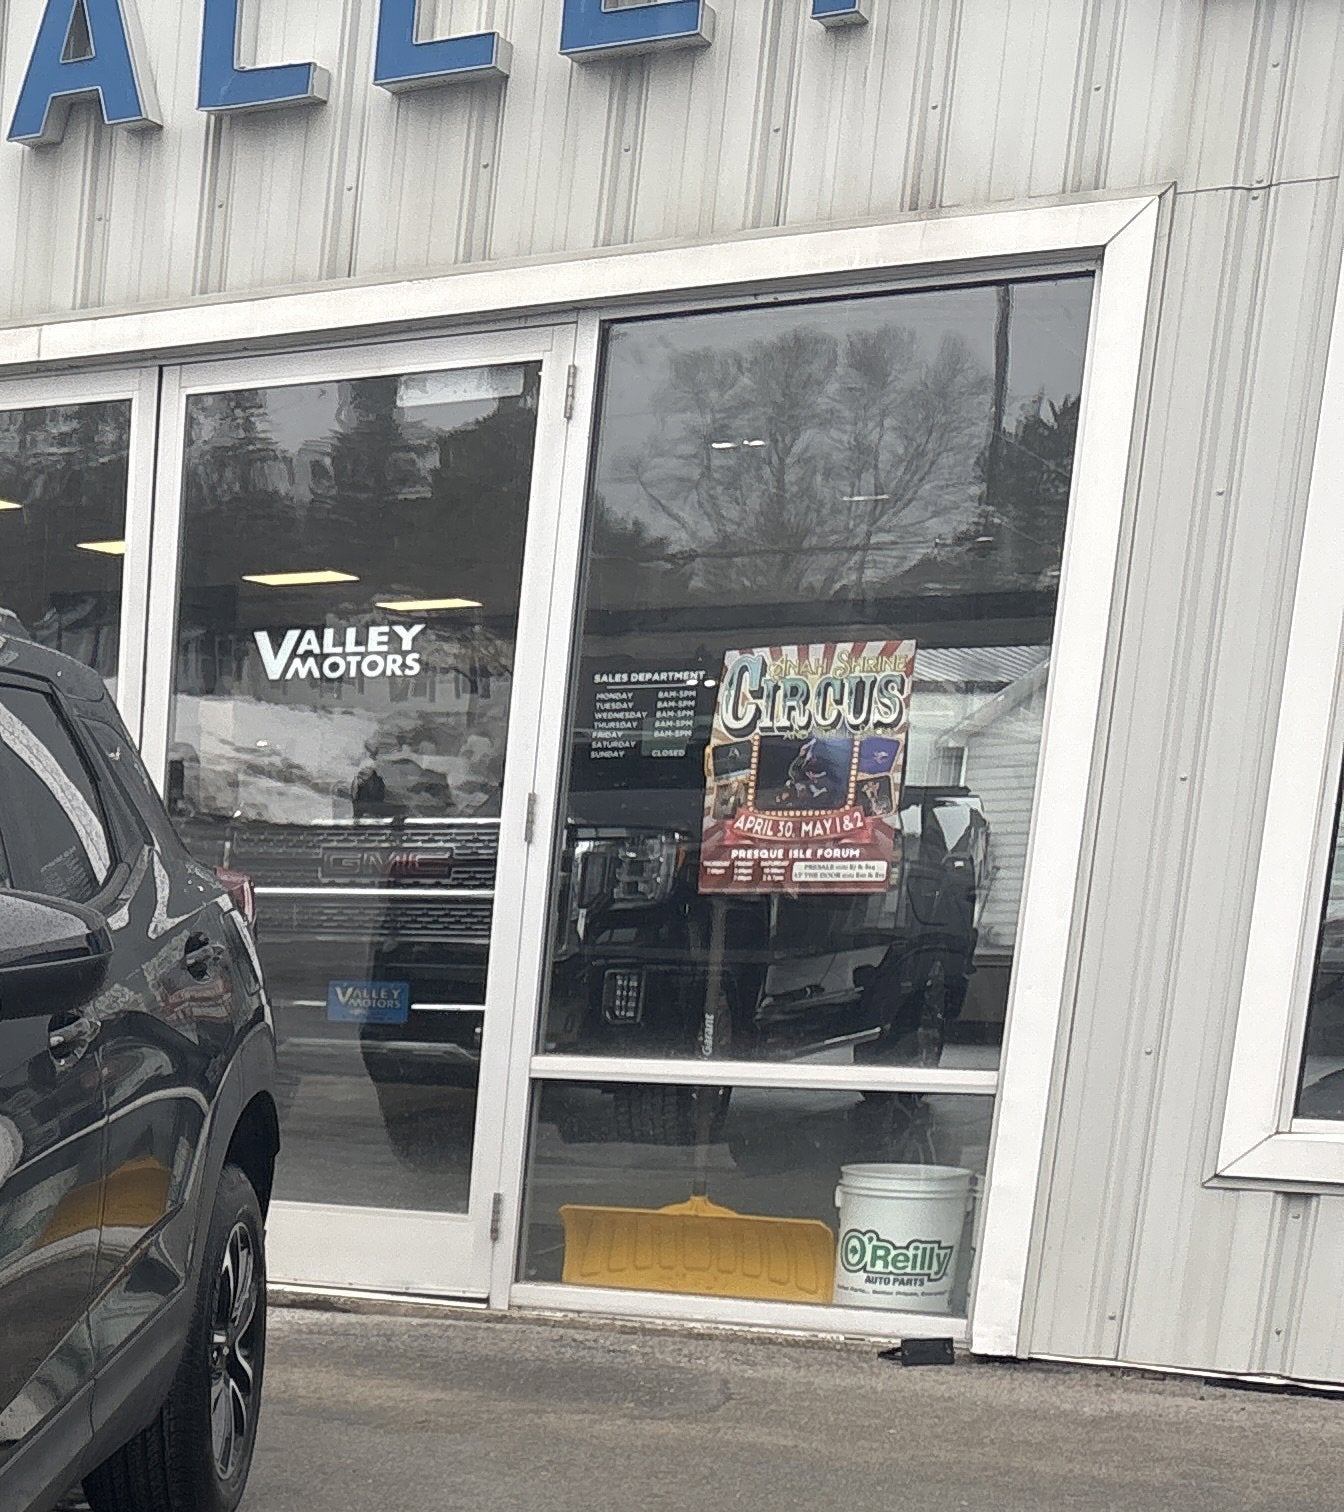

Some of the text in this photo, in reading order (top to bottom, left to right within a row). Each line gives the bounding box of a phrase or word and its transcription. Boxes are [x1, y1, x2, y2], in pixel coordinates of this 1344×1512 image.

[253, 624, 426, 681] VALLEY
[284, 652, 421, 680] MOTORS
[831, 650, 908, 679] SHRINE
[594, 670, 706, 683] SALES DEPARTMENT
[596, 692, 633, 700] MONDAY
[721, 654, 906, 738] CIRCUS
[596, 702, 634, 710] TUESDAY
[595, 711, 648, 720] WEDNESDAY
[594, 721, 638, 729] THURSDAY
[592, 731, 624, 739] FRIDAY
[591, 741, 637, 749] SATURDAY
[590, 750, 686, 759] SUNDAY CLOSED
[734, 815, 773, 836] APRIL
[801, 818, 832, 838] MAY
[842, 815, 853, 831] &
[853, 811, 863, 828] 2
[731, 848, 861, 859] PRESQUE ISLE FORUM
[323, 850, 451, 876] GMC
[335, 986, 401, 1004] VALLEY
[348, 998, 401, 1009] MOTORS
[842, 1230, 951, 1278] O'Reilly
[865, 1275, 925, 1287] AUTO PARTS
